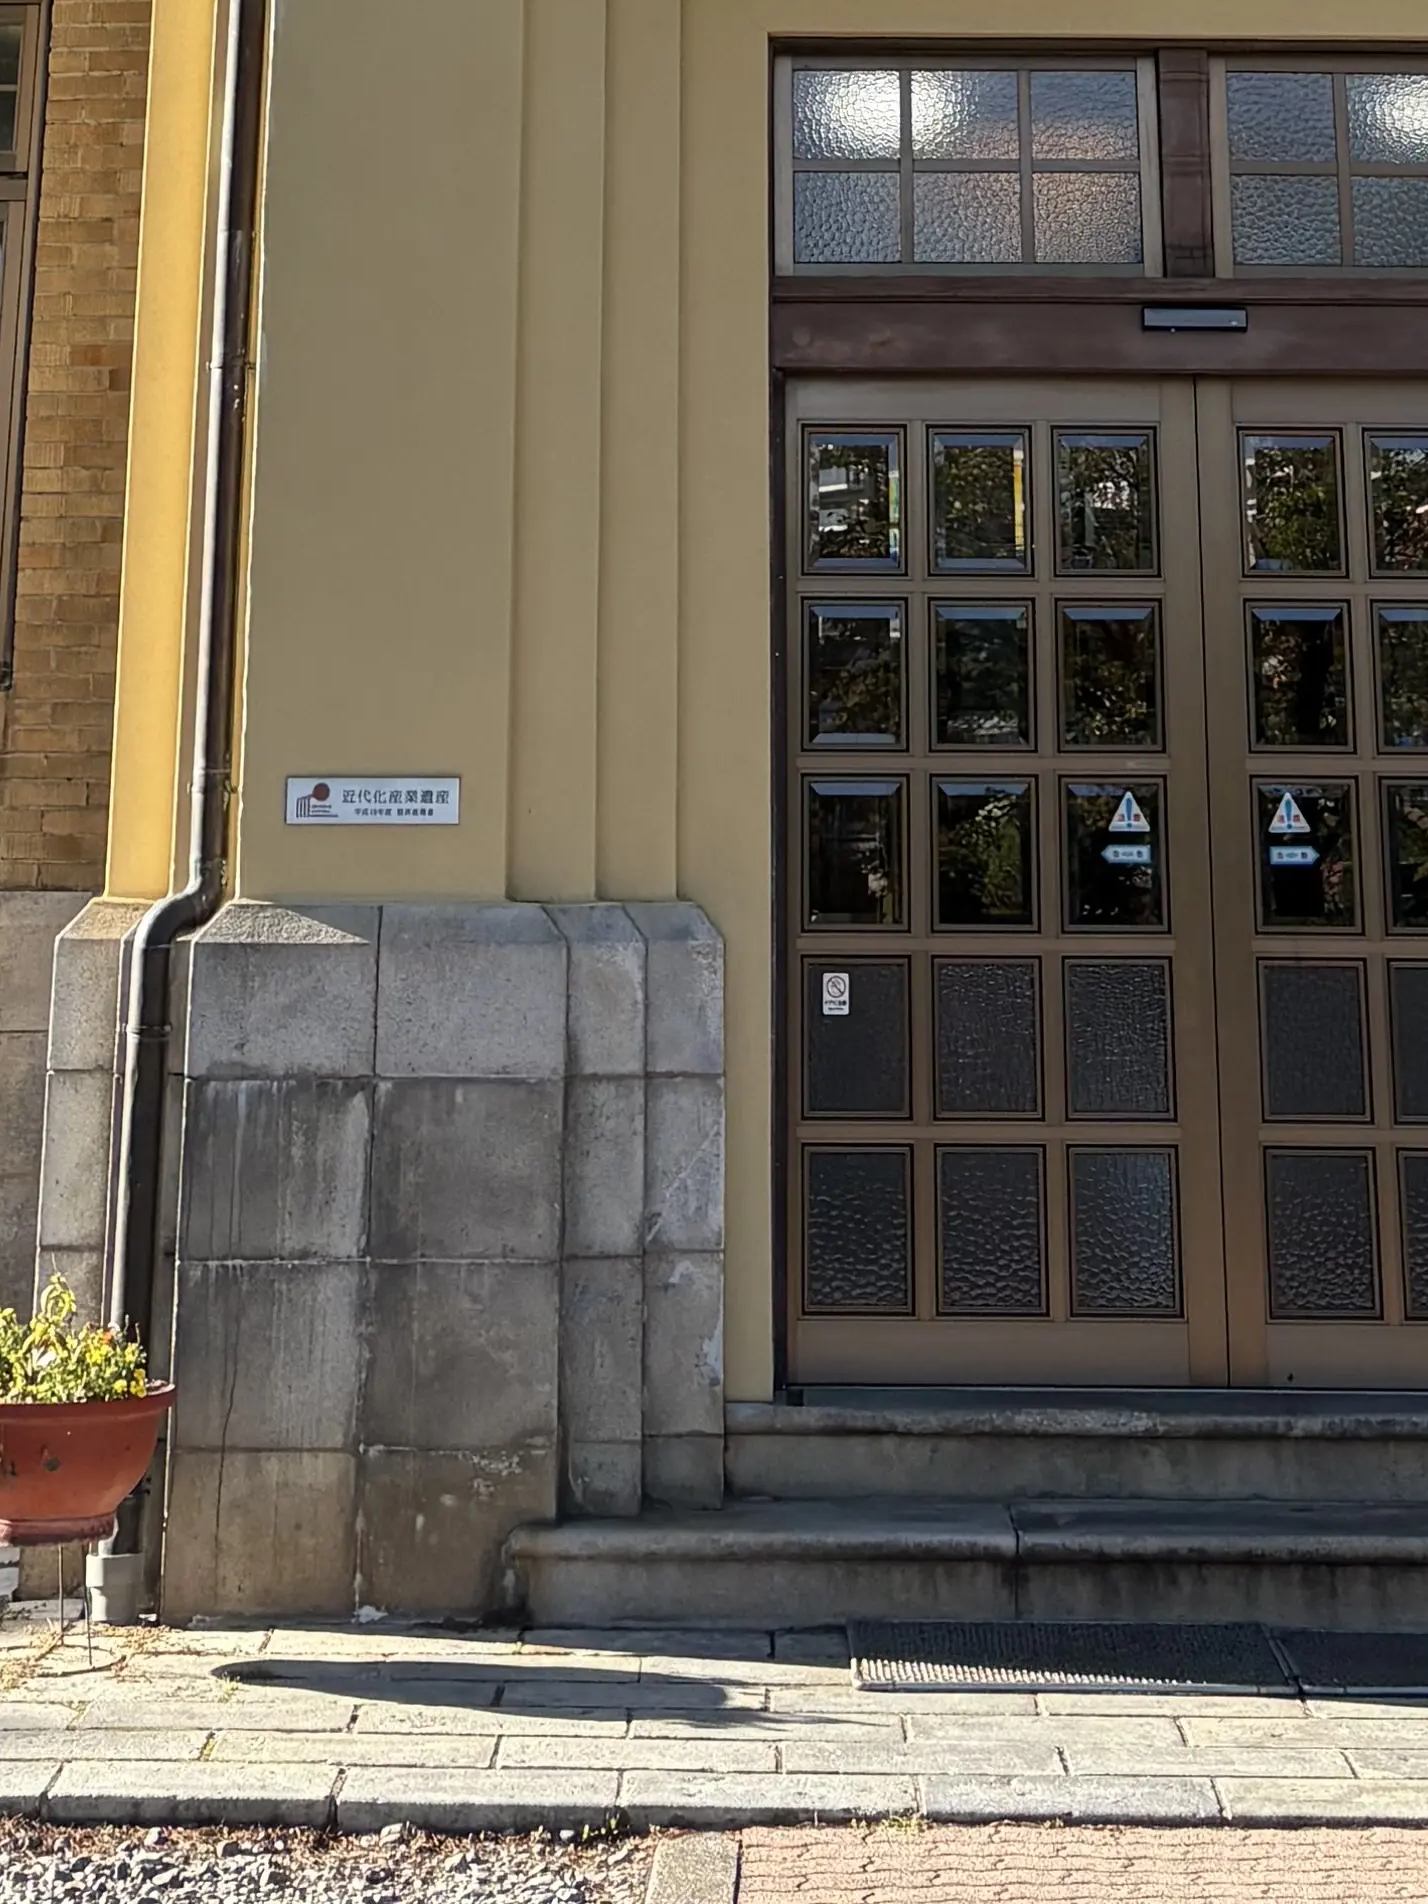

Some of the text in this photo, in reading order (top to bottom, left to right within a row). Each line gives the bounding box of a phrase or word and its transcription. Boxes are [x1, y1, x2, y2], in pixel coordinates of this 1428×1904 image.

[342, 789, 450, 805] 近代化産業遺産
